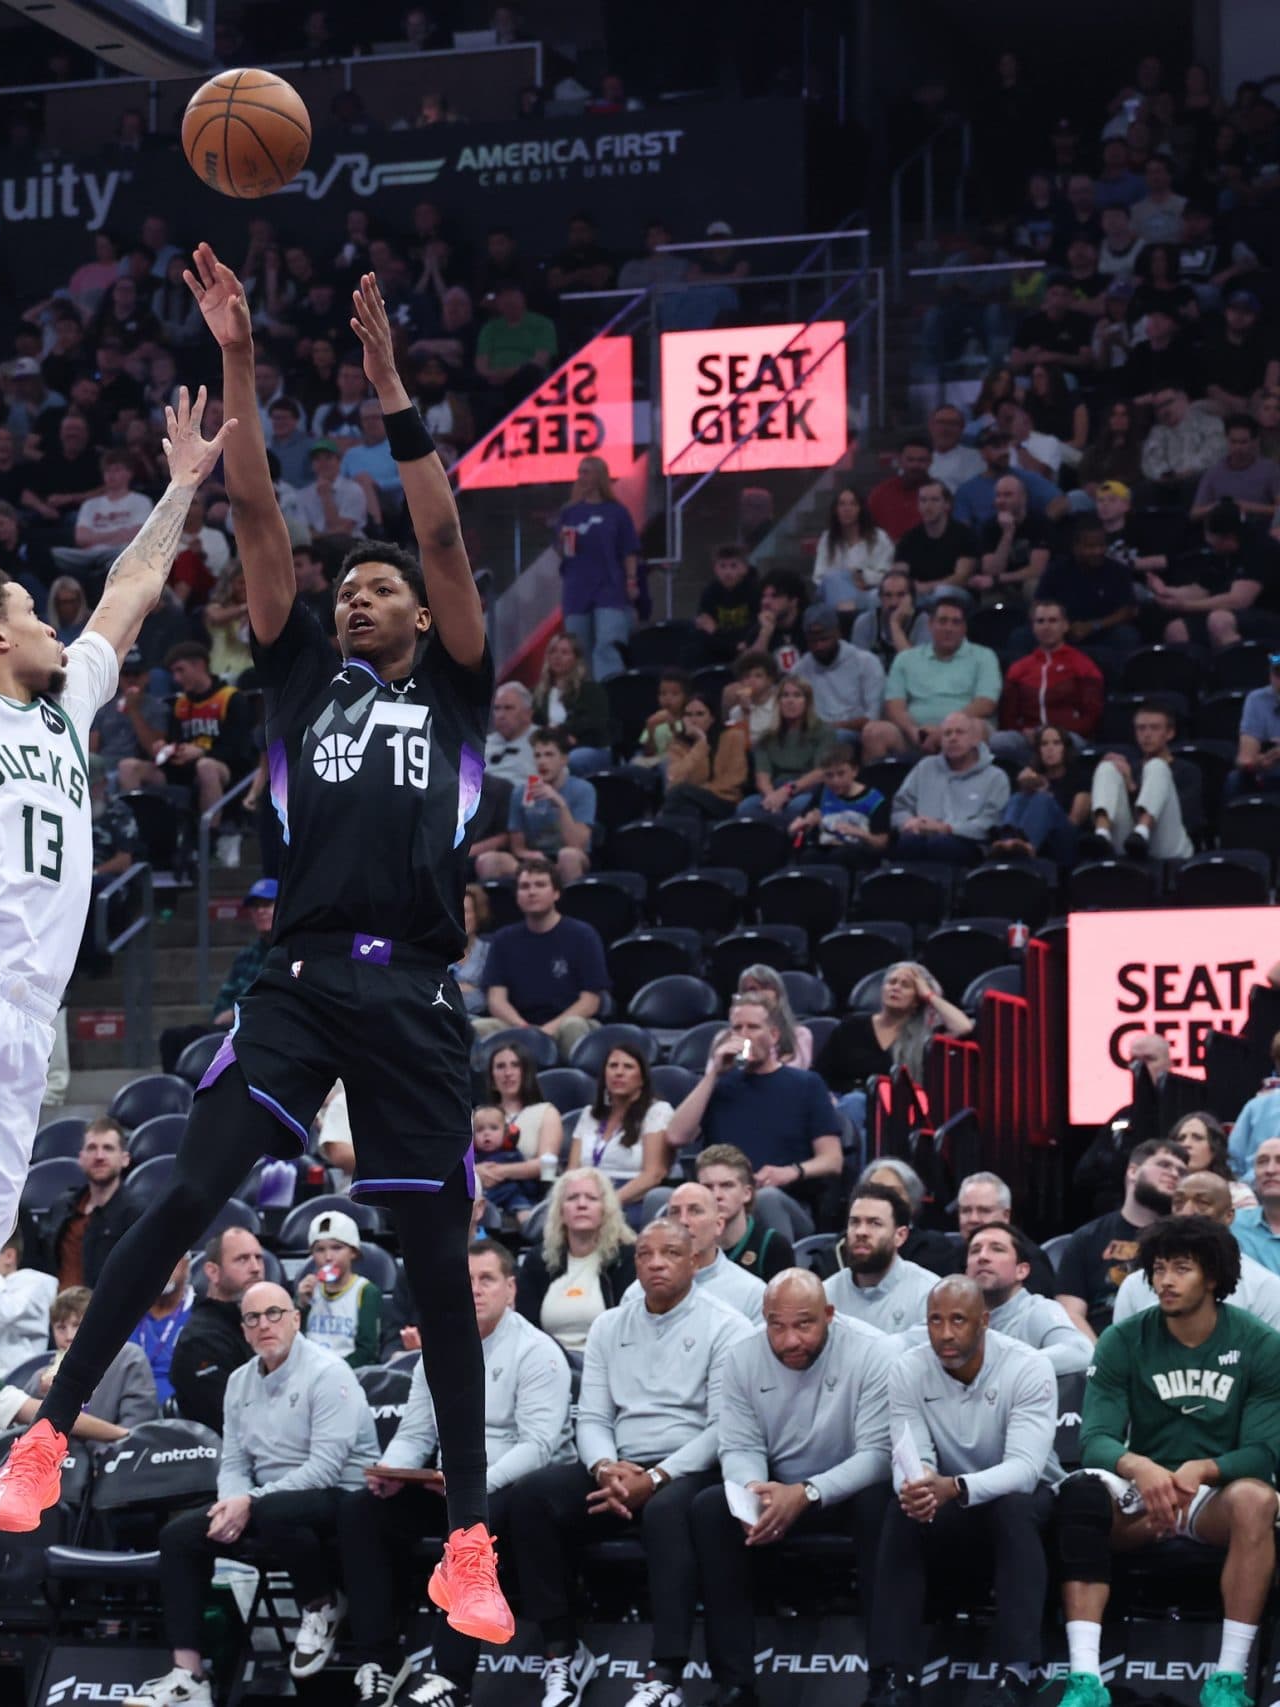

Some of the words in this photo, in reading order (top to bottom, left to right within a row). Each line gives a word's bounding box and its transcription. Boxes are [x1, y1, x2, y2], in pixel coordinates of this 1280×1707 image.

[456, 138, 589, 171] AMERICA
[596, 130, 684, 160] FIRST
[478, 167, 570, 186] CREDIT
[583, 160, 661, 178] UNION
[696, 349, 812, 397] SEAT
[691, 399, 817, 444] GEEK
[386, 733, 430, 790] 19
[21, 804, 64, 883] 13
[1117, 960, 1255, 1013] SEAT
[1152, 1369, 1235, 1402] BUCKS
[150, 1445, 217, 1464] entrata
[476, 1654, 545, 1673] EVINE
[772, 1654, 869, 1673] FILEVIN
[1125, 1661, 1248, 1680] FILEVI
